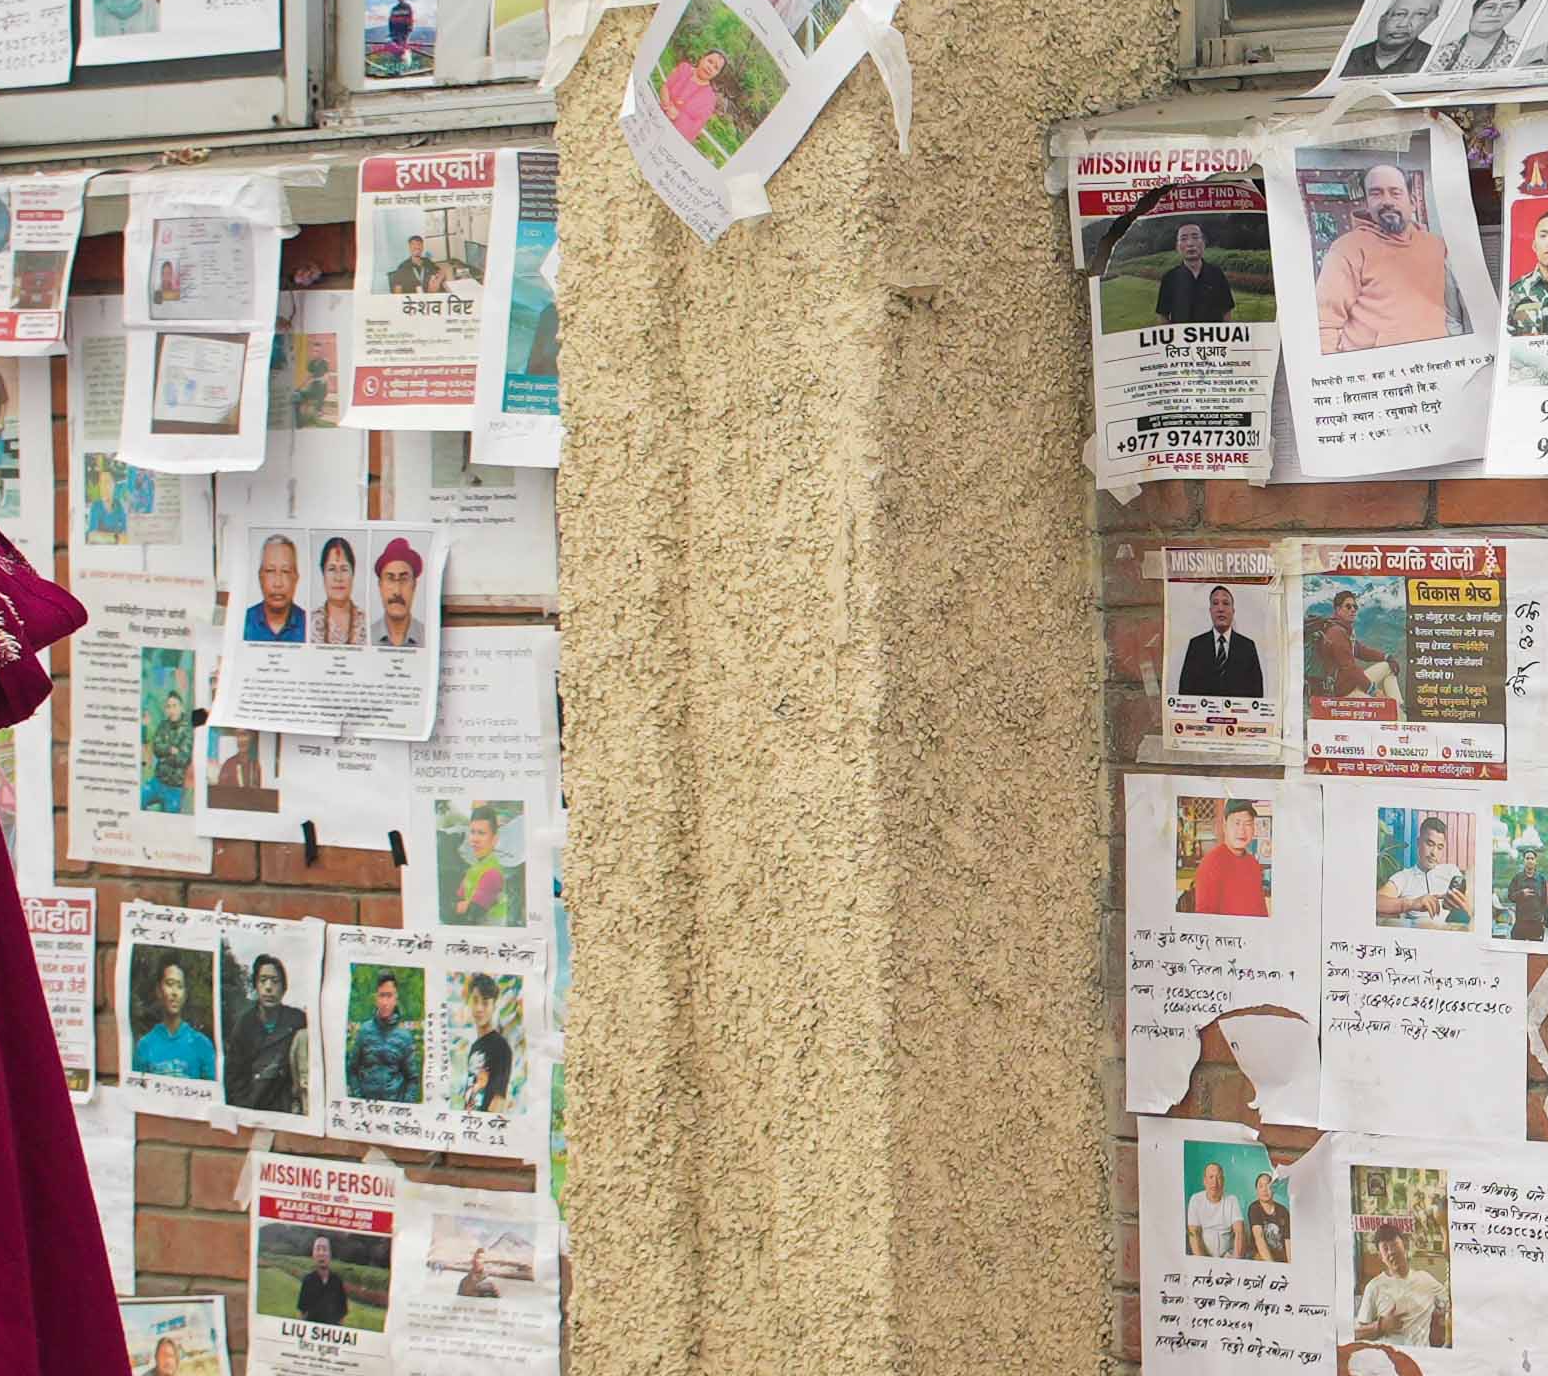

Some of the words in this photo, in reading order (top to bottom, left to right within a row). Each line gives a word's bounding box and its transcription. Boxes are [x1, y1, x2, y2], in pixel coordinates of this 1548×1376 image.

[1139, 328, 1174, 348] LIU
[1183, 326, 1250, 344] SHUAI
[1172, 551, 1224, 573] MISSING
[260, 1162, 322, 1189] MISSING
[327, 1170, 395, 1198] PERSON
[282, 1322, 306, 1338] LIU
[311, 1326, 357, 1345] SHUAI
